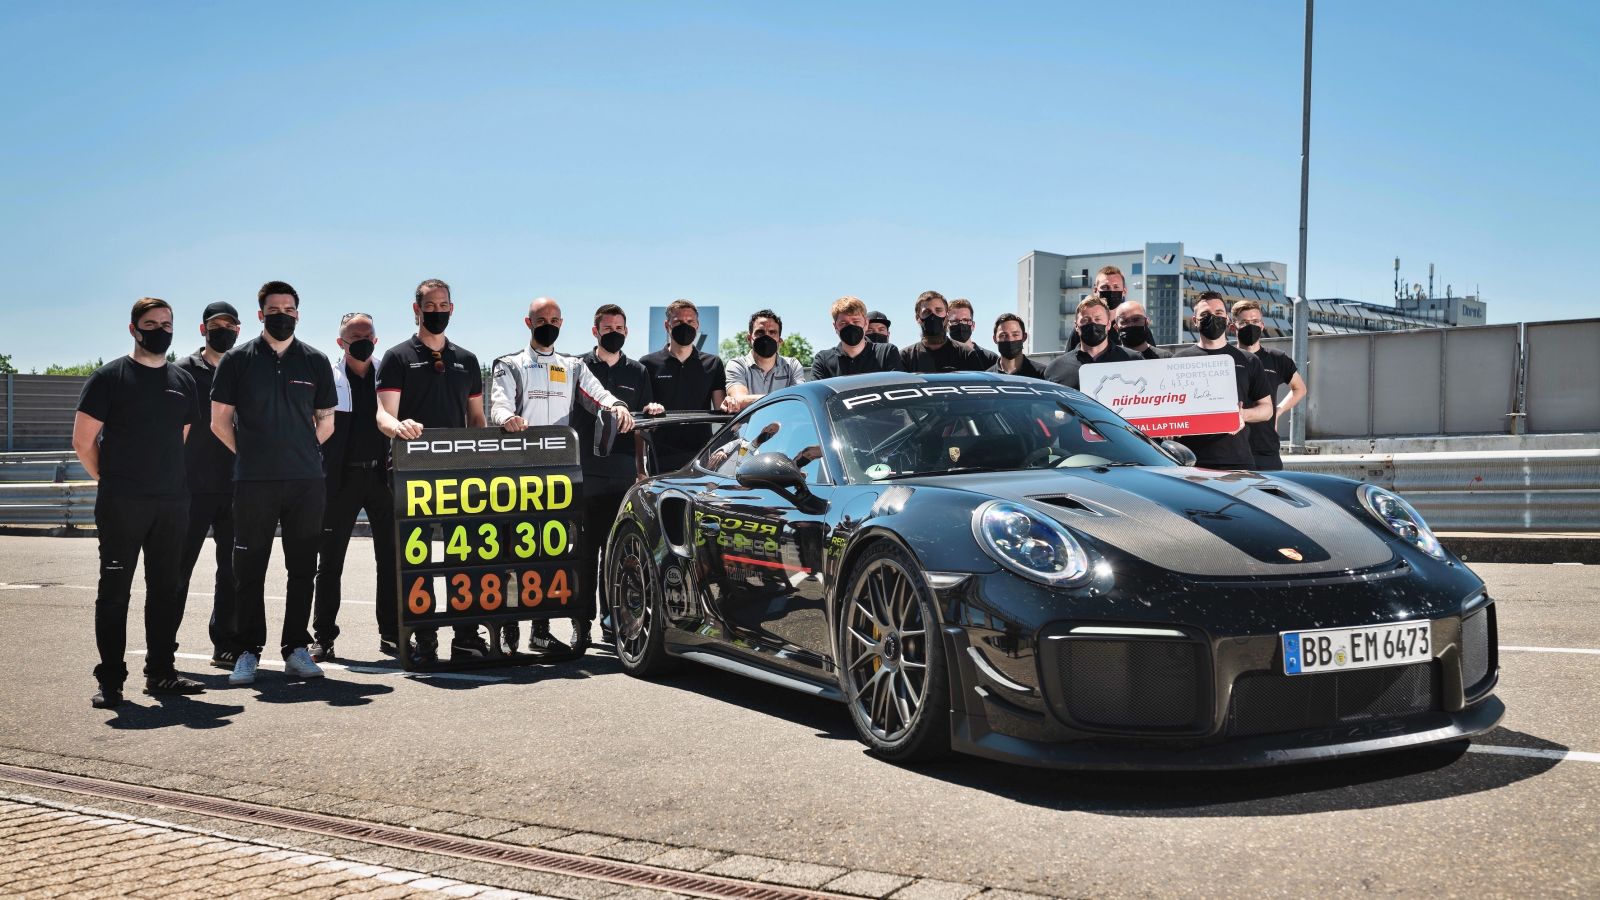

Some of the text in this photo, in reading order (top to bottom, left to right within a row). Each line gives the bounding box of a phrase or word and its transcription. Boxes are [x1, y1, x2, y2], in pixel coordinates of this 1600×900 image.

[1167, 360, 1230, 370] NORDSCHLEIFE
[1176, 369, 1231, 380] SPORTS CARS
[842, 385, 1092, 410] PORSCHE
[1112, 392, 1187, 407] nürburgring
[1152, 422, 1168, 431] LAP
[1169, 421, 1190, 429] TIME
[406, 436, 567, 453] PORSCHE
[406, 474, 573, 517] RECORD
[404, 520, 567, 565] 6 43 30
[408, 569, 573, 615] 6 38 84
[1302, 636, 1332, 667] BB
[1351, 632, 1379, 663] EM
[1383, 626, 1429, 659] 6473
